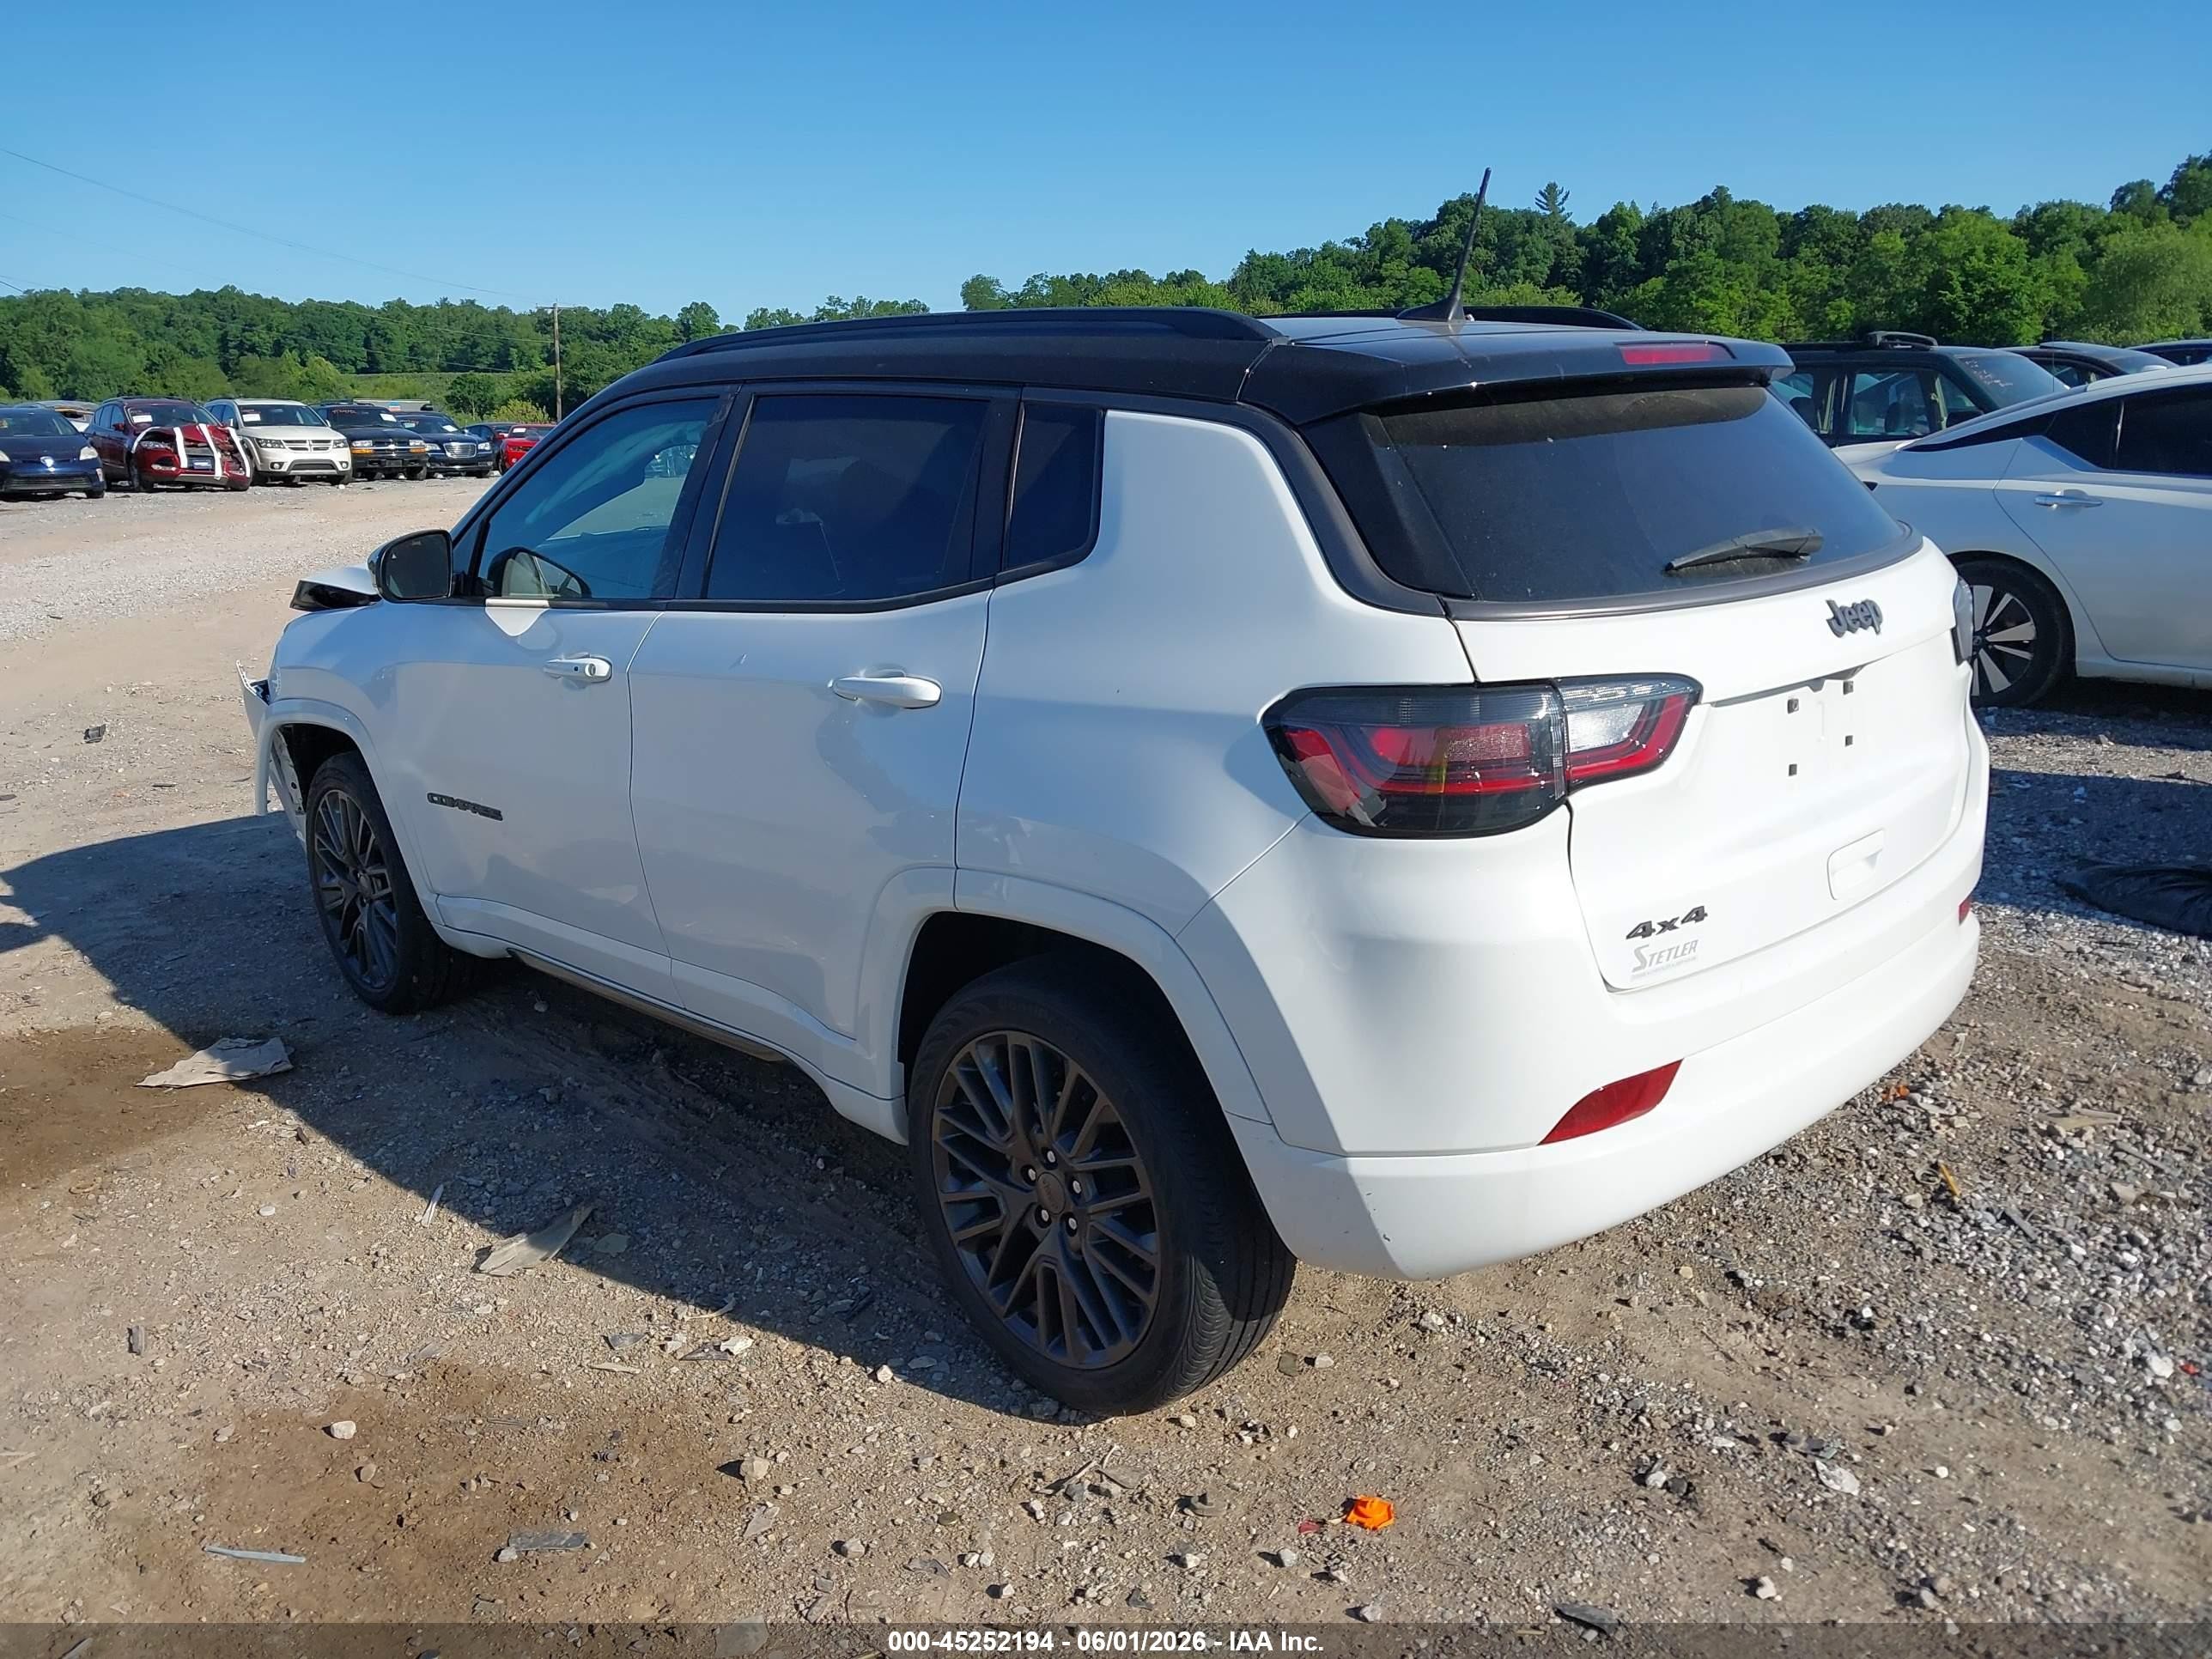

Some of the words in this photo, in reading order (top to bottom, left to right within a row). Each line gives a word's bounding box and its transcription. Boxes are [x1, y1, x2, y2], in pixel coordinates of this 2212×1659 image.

[1825, 599, 1883, 638] Jeep
[1626, 905, 1708, 940] 4x4
[1632, 939, 1698, 973] STETLER
